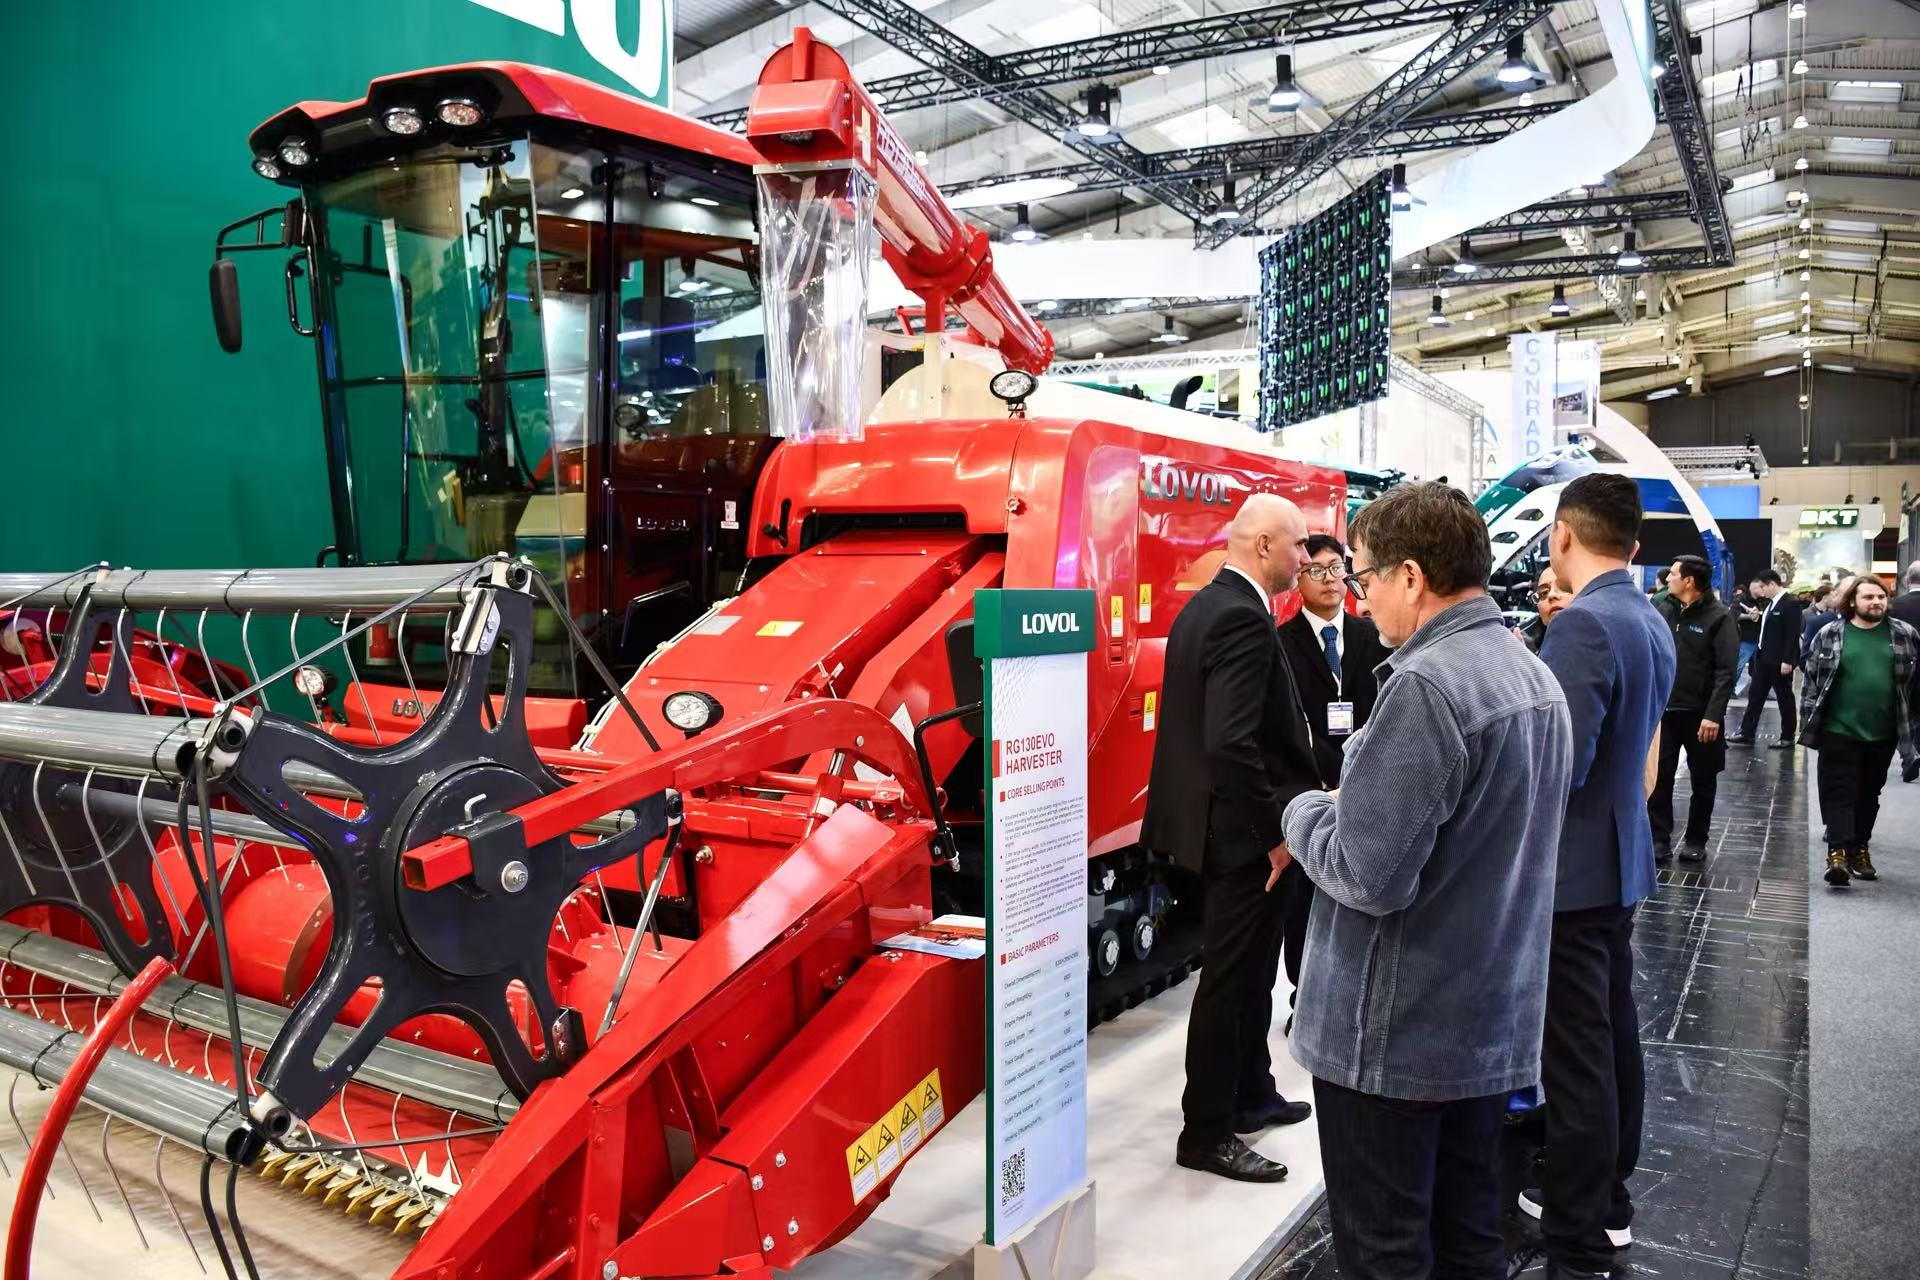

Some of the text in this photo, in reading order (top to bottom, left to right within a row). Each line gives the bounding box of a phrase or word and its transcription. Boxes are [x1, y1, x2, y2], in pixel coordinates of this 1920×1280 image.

[1524, 338, 1541, 456] CONRAD
[1143, 461, 1232, 506] LOVOL
[1799, 509, 1858, 527] BKT
[1022, 611, 1080, 635] LOVOL
[1006, 732, 1055, 756] RG130EVO
[1006, 749, 1063, 775] HARVESTER
[1007, 776, 1066, 800] CORE SELLING POINTS
[1008, 931, 1060, 963] BASIC PARAMETERS
